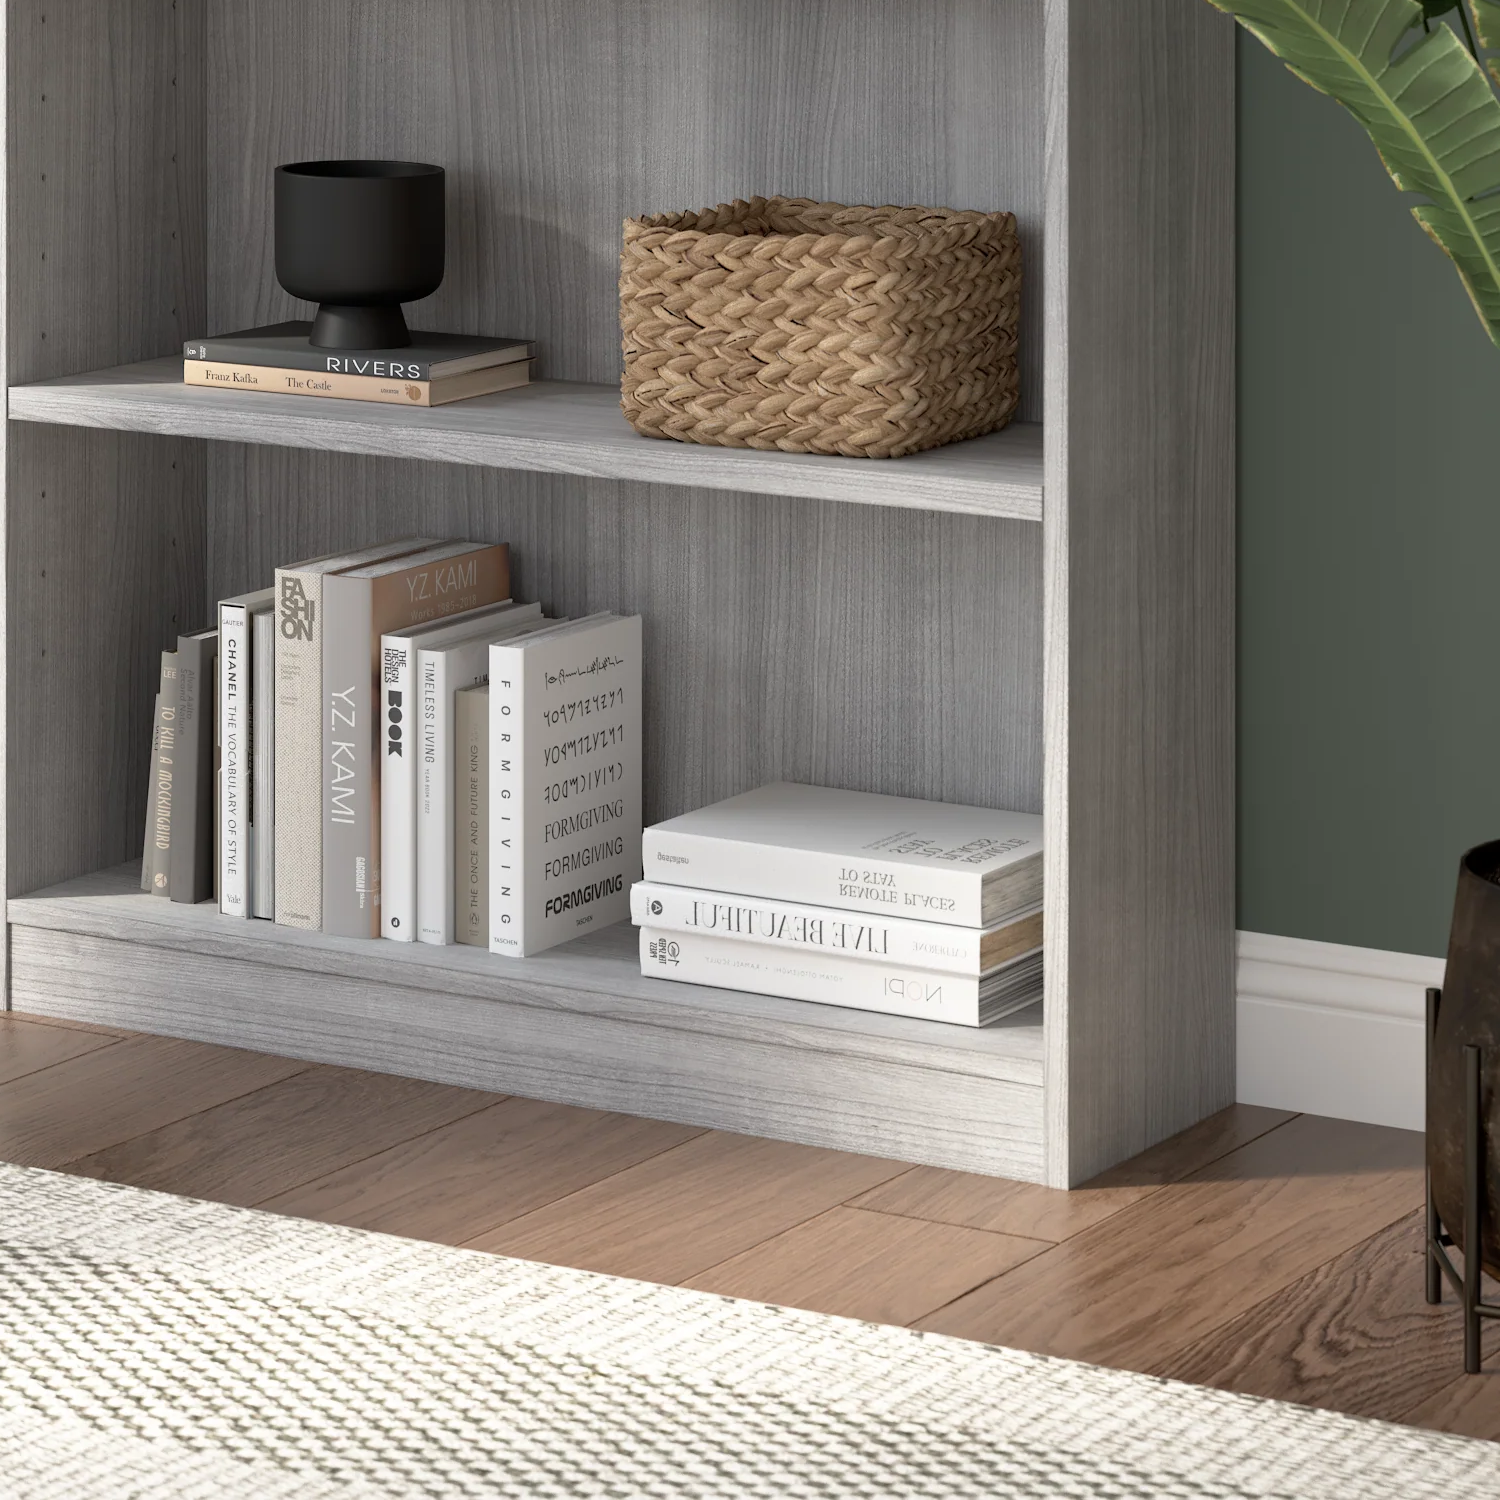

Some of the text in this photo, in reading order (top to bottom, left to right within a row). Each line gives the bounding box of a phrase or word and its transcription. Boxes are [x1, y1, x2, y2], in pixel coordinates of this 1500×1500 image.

[205, 370, 258, 384] Franz Kafka
[285, 377, 332, 391] The Castle
[327, 357, 420, 378] RIVERS
[406, 560, 477, 602] Y.Z. KAMI
[410, 604, 435, 621] Works
[163, 670, 176, 679] LEE
[384, 647, 392, 684] HOTELS
[398, 650, 406, 668] THE
[180, 668, 188, 701] Second
[186, 669, 195, 720] Alvar Aalto
[388, 690, 403, 758] BOOK
[424, 662, 435, 763] TIMELESS LIVING
[228, 639, 237, 876] CHANEL THE VOCABULARY OF STYLE
[331, 686, 355, 824] Y.Z. KAMI
[155, 706, 176, 849] TO KILL A MOCKINGBIRD
[500, 679, 510, 924] FORMGIVING
[544, 799, 623, 843] FORMGIVING
[470, 746, 478, 907] THE ONCE AND FUTURE KING
[356, 857, 365, 892] GAGOSIAN
[545, 837, 623, 881] FORMGIVING
[226, 893, 241, 905] Yale
[545, 873, 623, 918] FORMGIVING
[494, 936, 518, 946] TASCHEN
